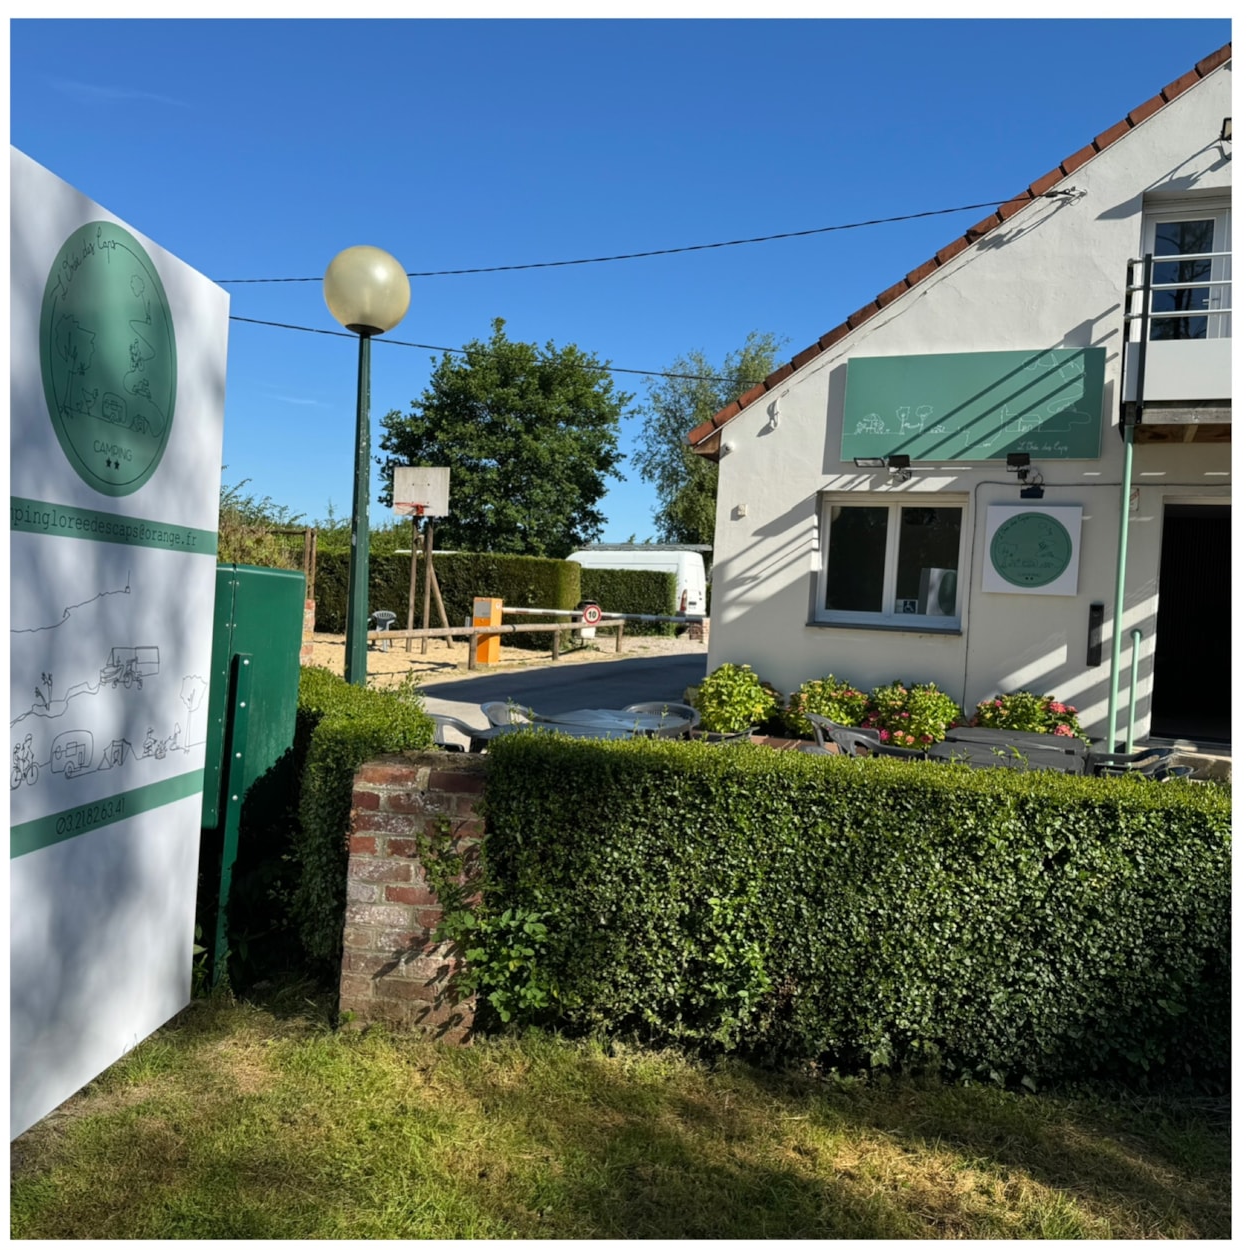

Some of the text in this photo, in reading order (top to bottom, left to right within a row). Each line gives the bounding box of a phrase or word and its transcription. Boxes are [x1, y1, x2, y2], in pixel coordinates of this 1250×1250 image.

[83, 238, 95, 258] des
[96, 226, 116, 264] Caps
[93, 439, 133, 462] CAMPING
